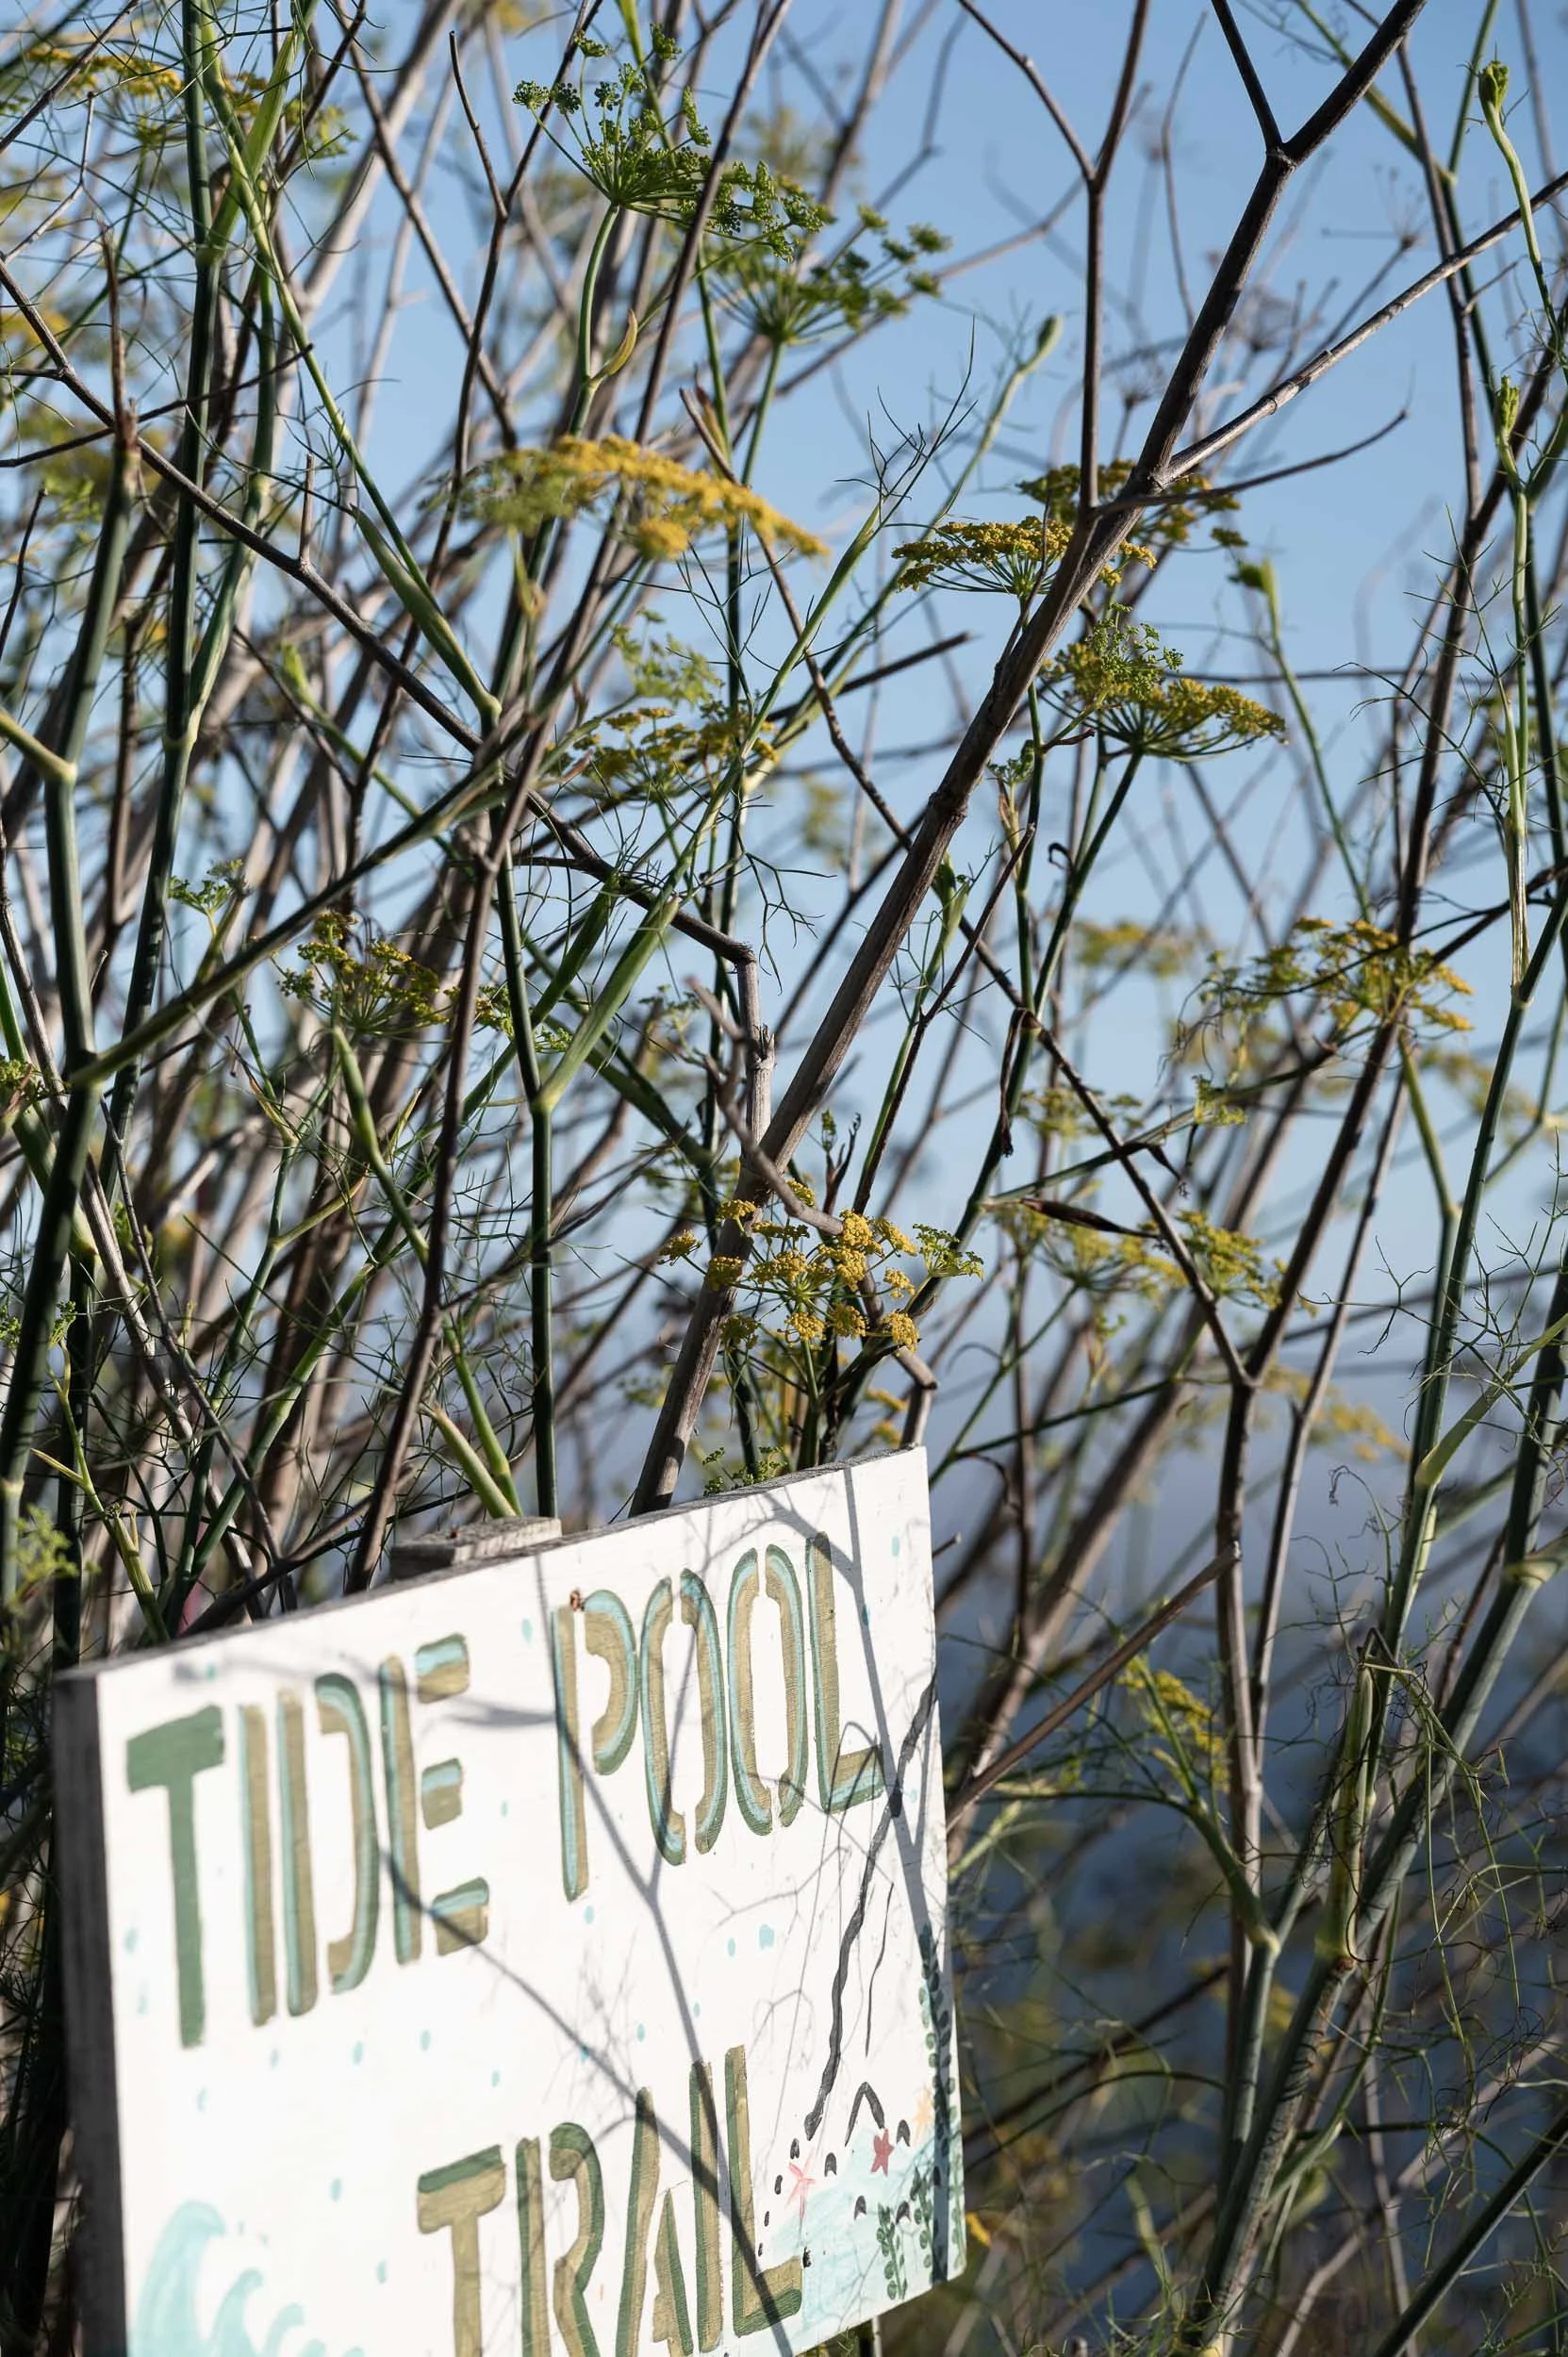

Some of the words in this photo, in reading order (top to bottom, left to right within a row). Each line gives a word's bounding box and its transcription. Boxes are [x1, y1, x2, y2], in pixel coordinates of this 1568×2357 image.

[125, 1632, 489, 2048] TIDE
[551, 1531, 887, 1902] POOL
[416, 2044, 804, 2357] TRAIL
